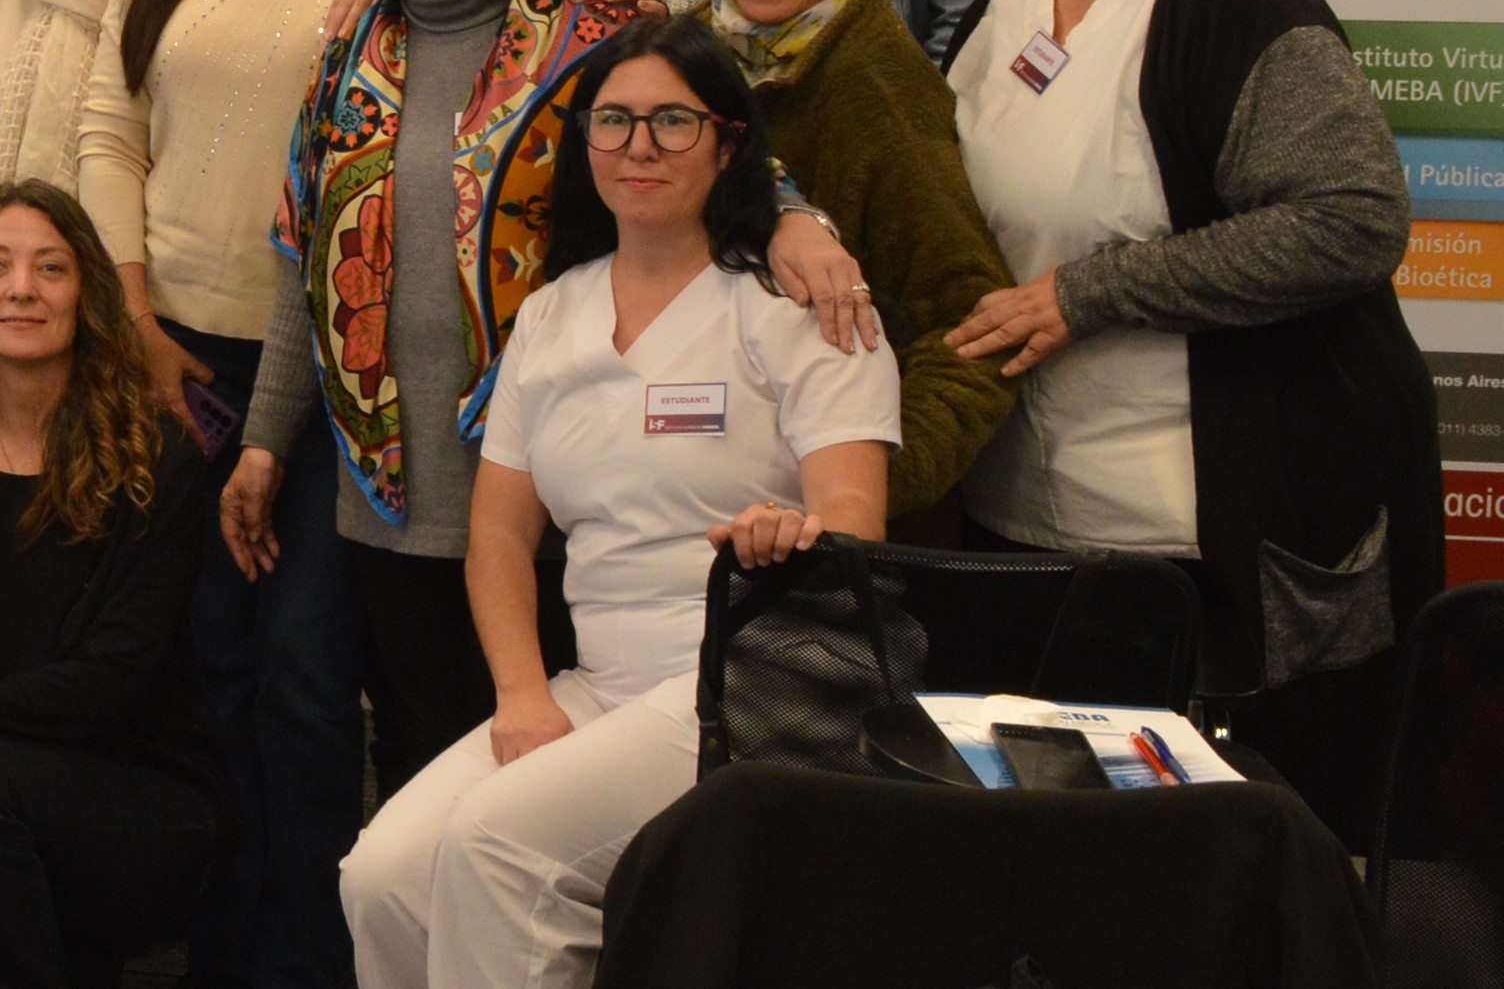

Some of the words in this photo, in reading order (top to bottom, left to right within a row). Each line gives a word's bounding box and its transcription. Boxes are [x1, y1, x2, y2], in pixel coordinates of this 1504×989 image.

[1352, 45, 1434, 69] stituto
[1395, 264, 1493, 289] Bioética
[661, 396, 710, 405] ESTUDIANTE
